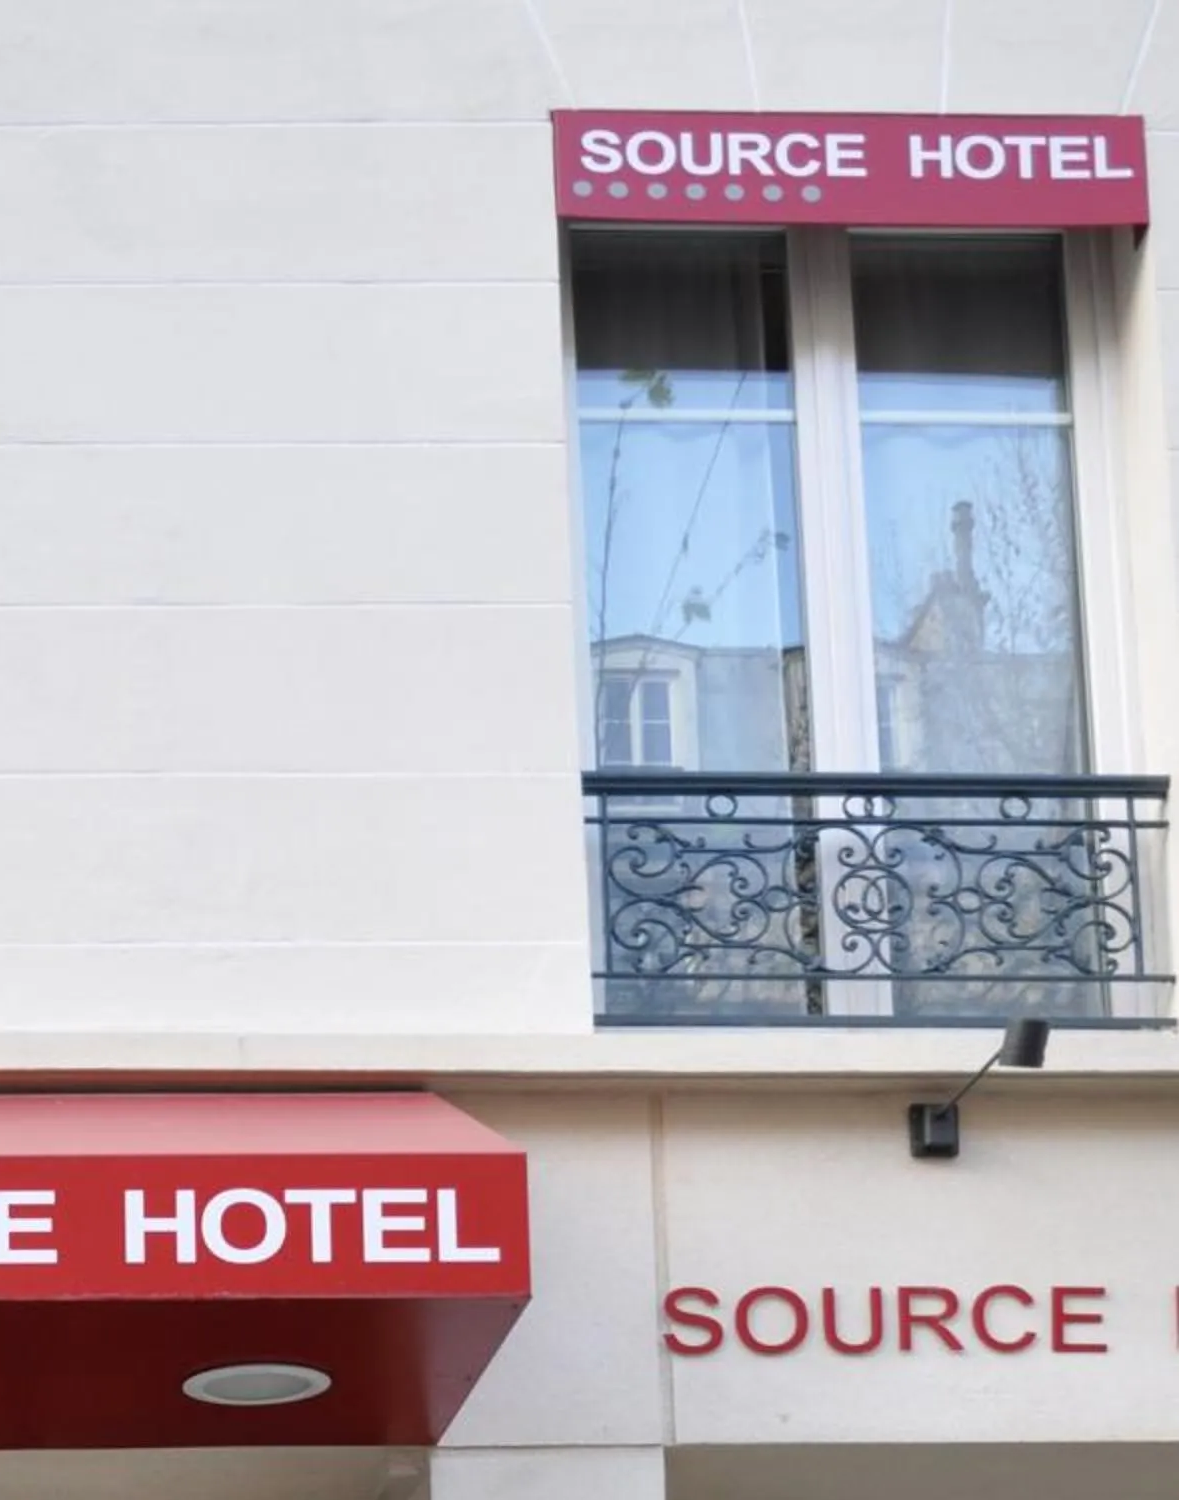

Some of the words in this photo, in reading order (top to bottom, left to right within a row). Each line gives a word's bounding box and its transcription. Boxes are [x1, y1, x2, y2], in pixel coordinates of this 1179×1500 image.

[580, 129, 868, 178] SOURCE
[909, 133, 1133, 180] HOTEL
[124, 1187, 501, 1264] HOTEL
[662, 1284, 1108, 1356] SOURCE
